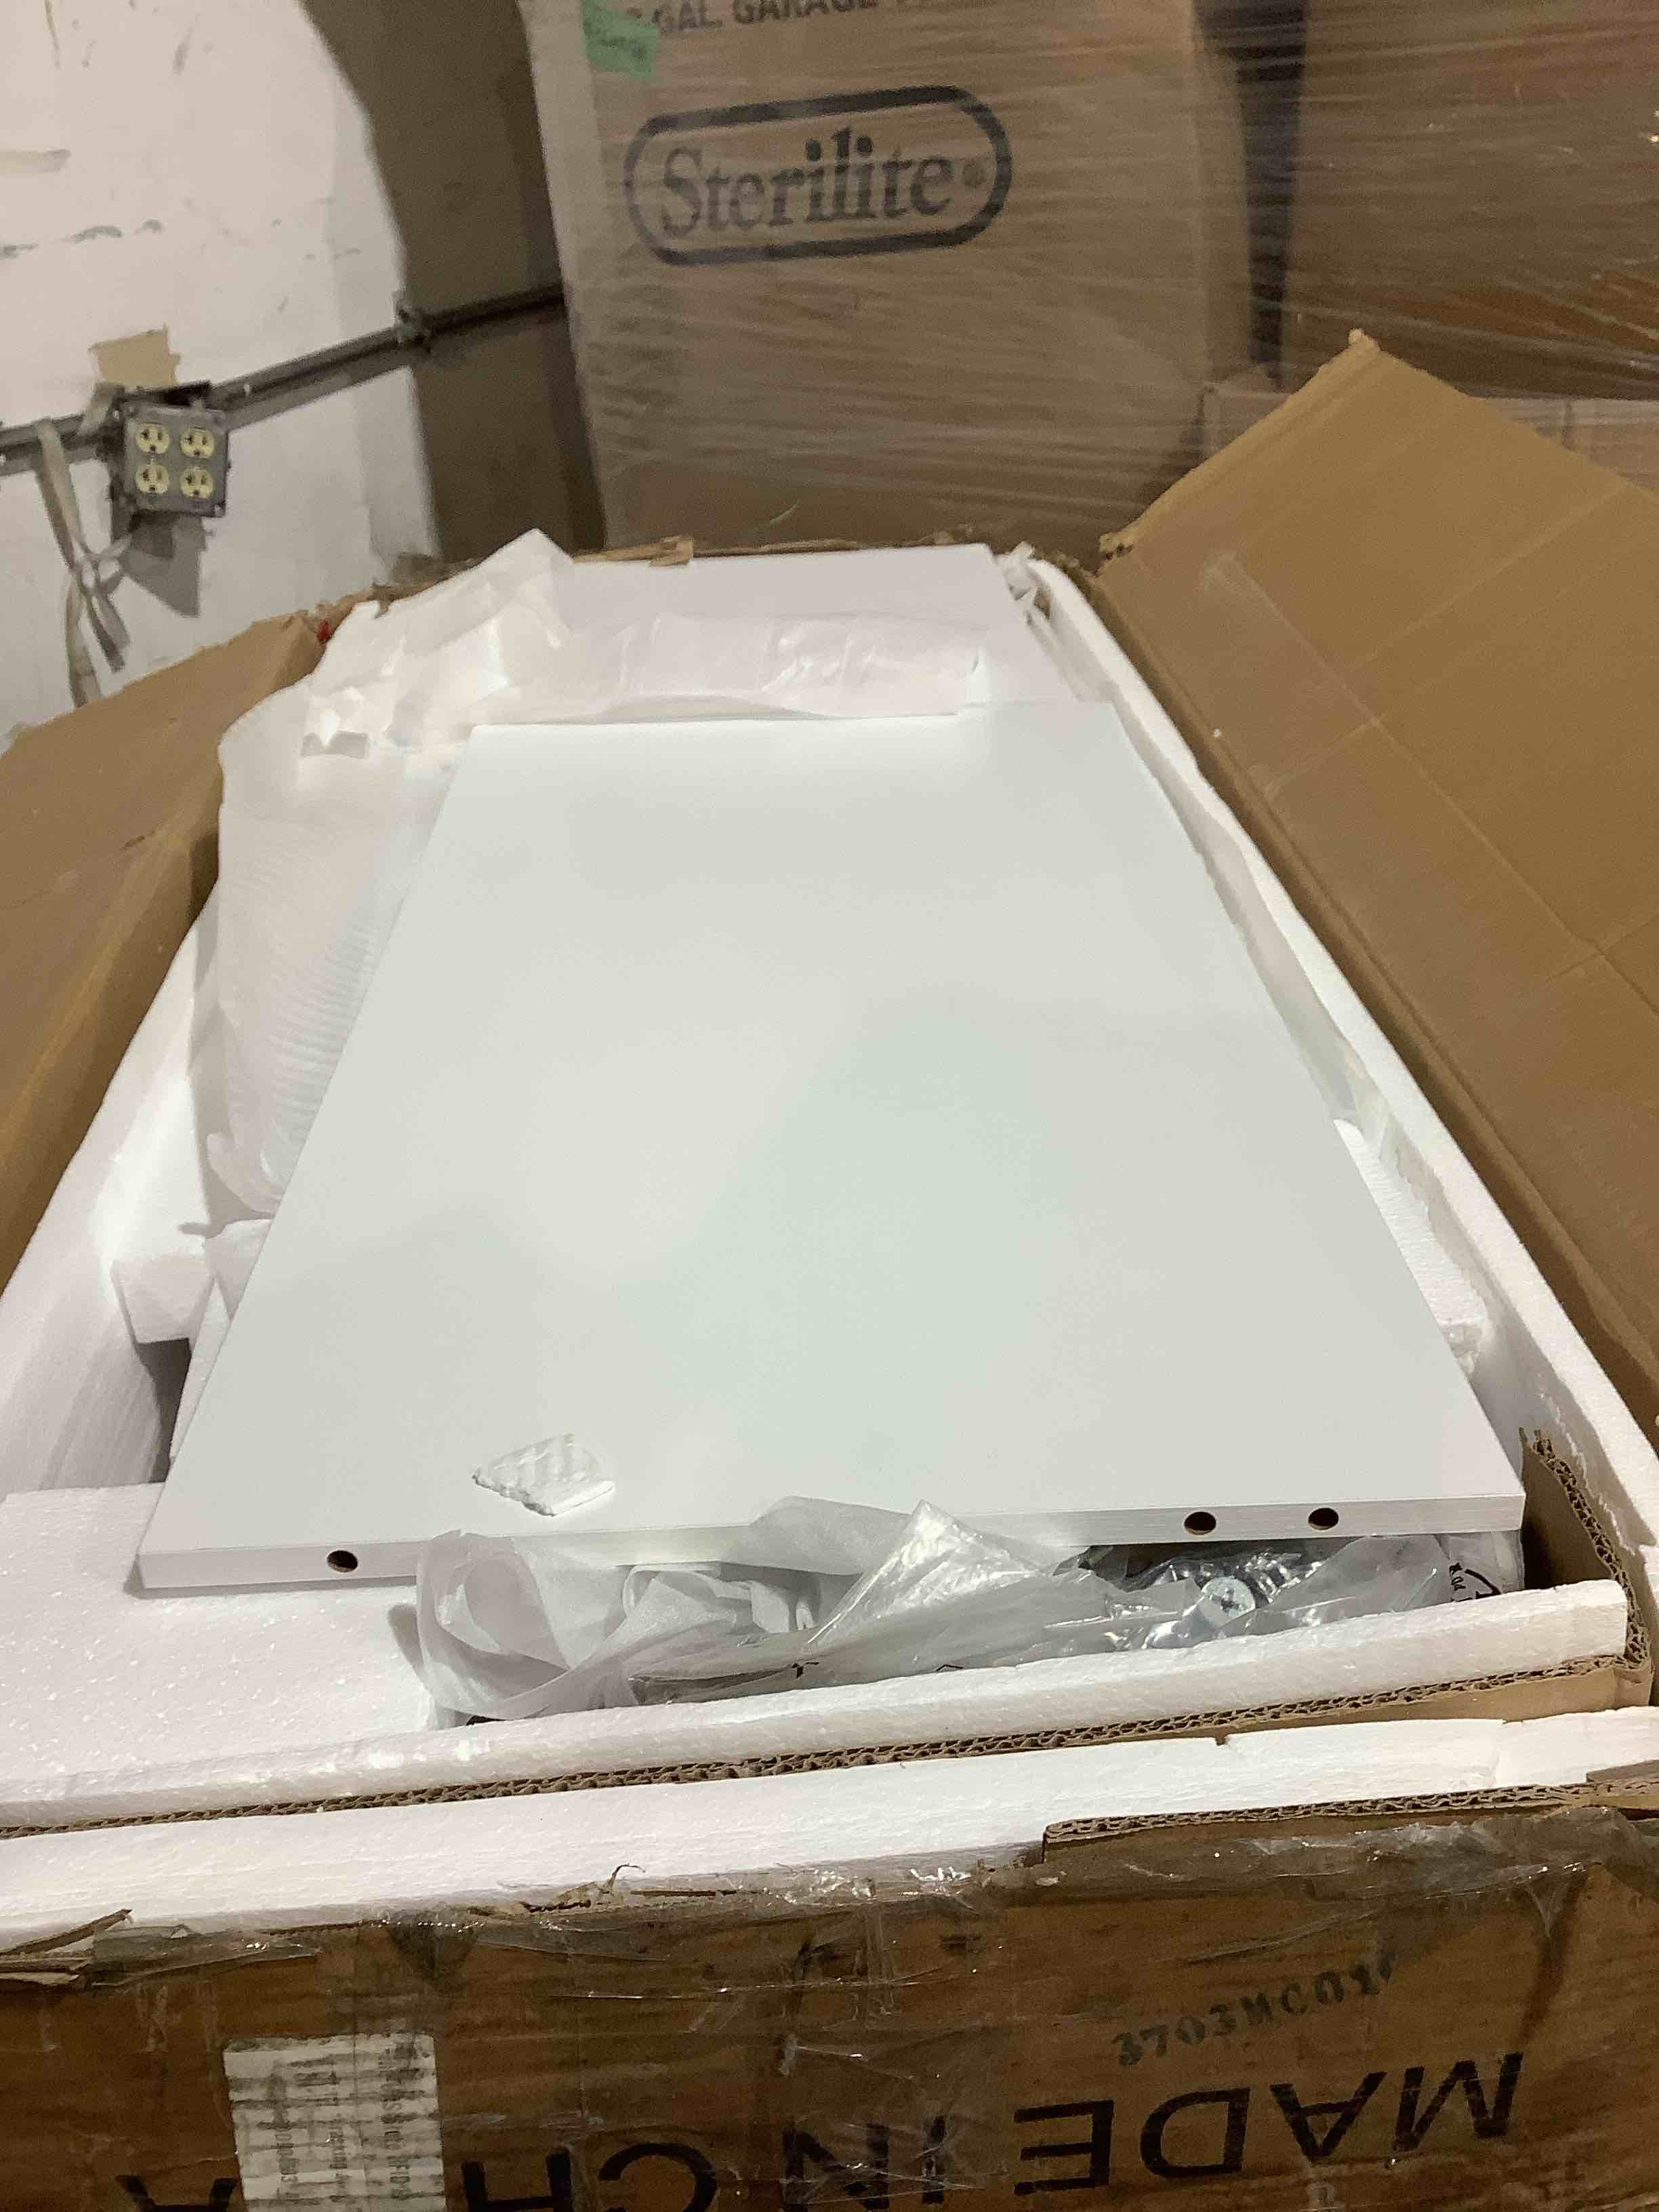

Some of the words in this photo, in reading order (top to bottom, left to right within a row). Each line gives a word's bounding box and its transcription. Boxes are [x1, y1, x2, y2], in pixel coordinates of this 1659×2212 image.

[661, 127, 954, 237] Sterilite
[780, 2113, 945, 2212] IN
[1014, 2051, 1524, 2195] MADE
